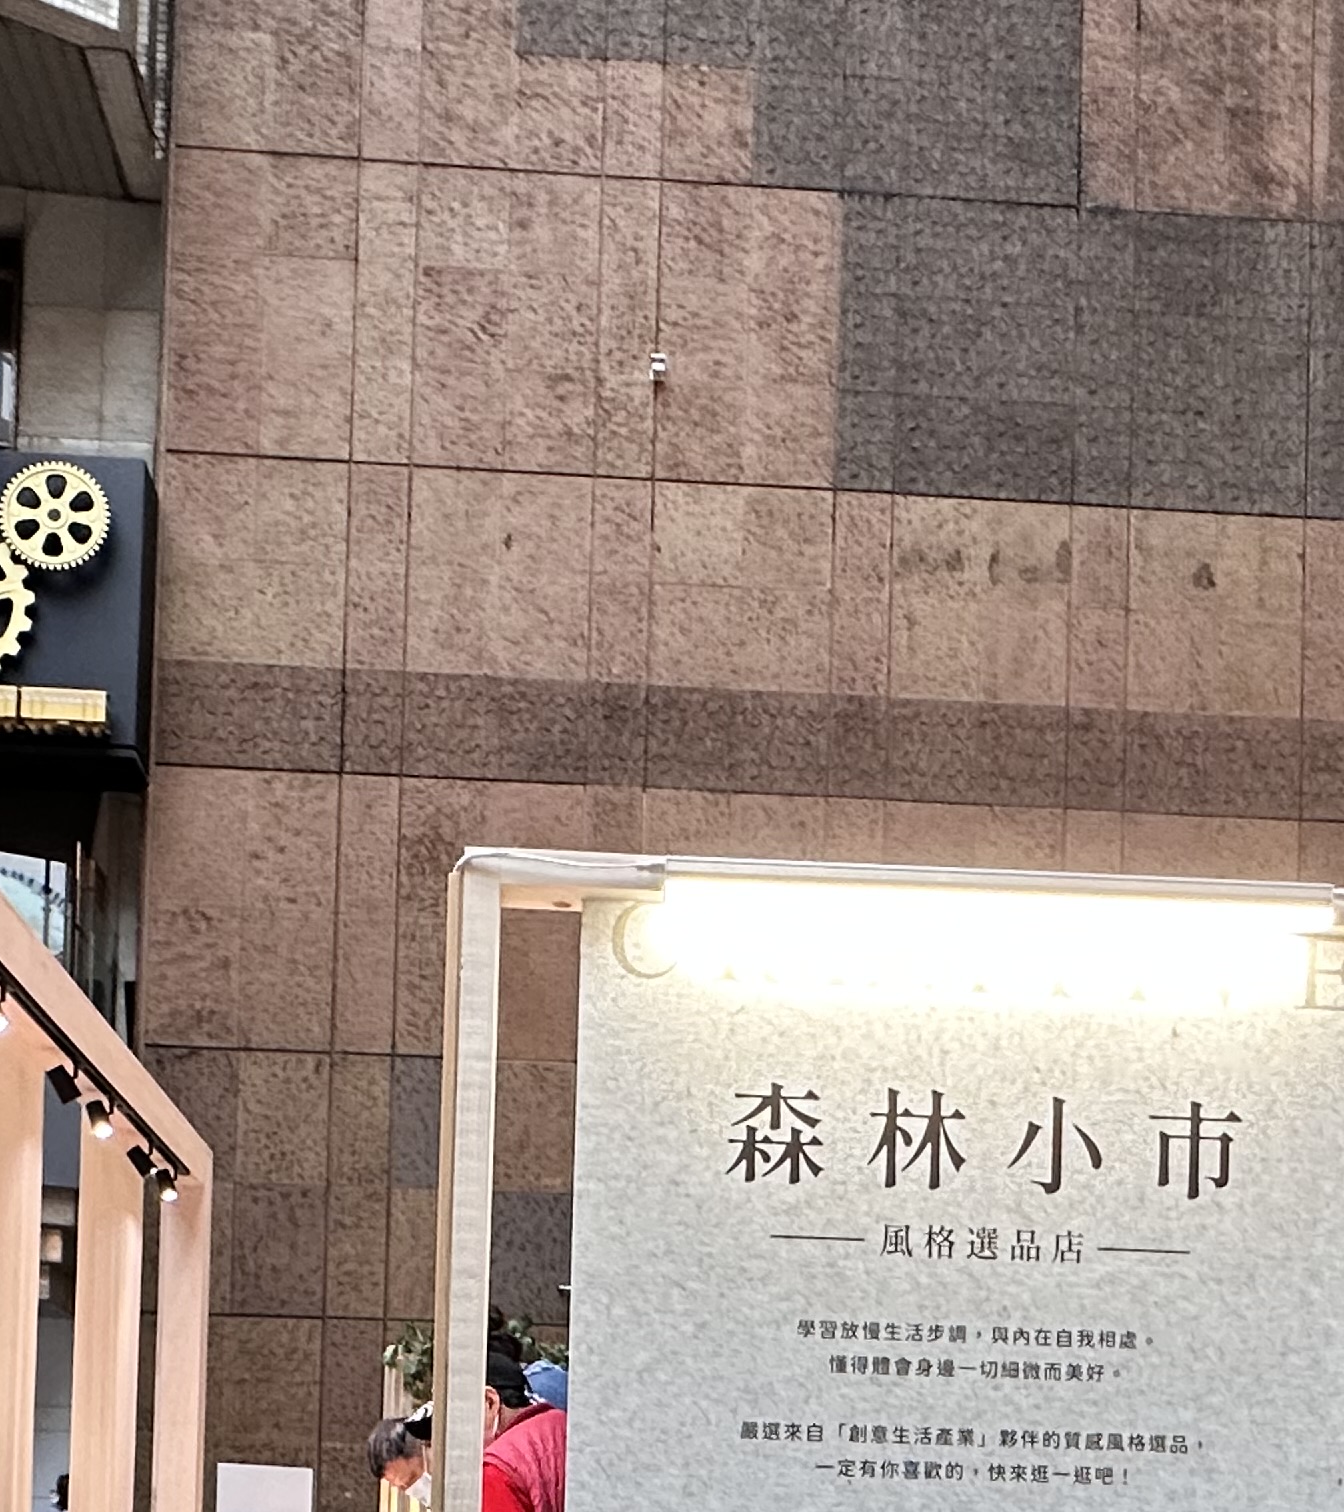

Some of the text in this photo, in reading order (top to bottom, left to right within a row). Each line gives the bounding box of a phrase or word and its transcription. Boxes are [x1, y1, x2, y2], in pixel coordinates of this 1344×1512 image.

[724, 1082, 1243, 1201] 森林小市
[879, 1223, 1084, 1265] 風格選品店
